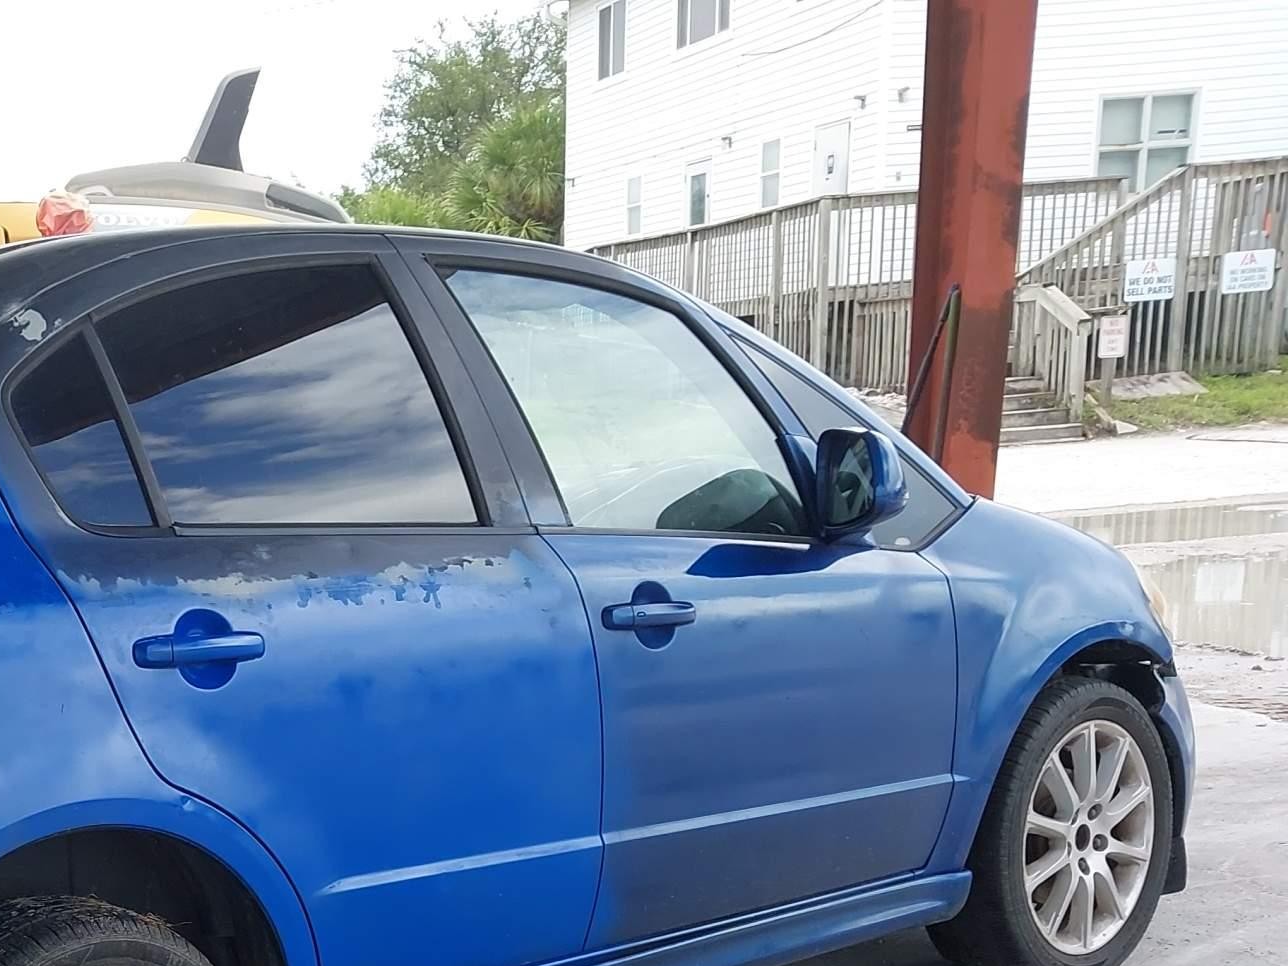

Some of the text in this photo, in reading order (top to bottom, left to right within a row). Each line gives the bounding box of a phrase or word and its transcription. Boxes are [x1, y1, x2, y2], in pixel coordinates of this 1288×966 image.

[92, 213, 176, 226] OLVO
[1128, 274, 1173, 286] WE DO NOT
[1125, 285, 1173, 296] SELL PARTS
